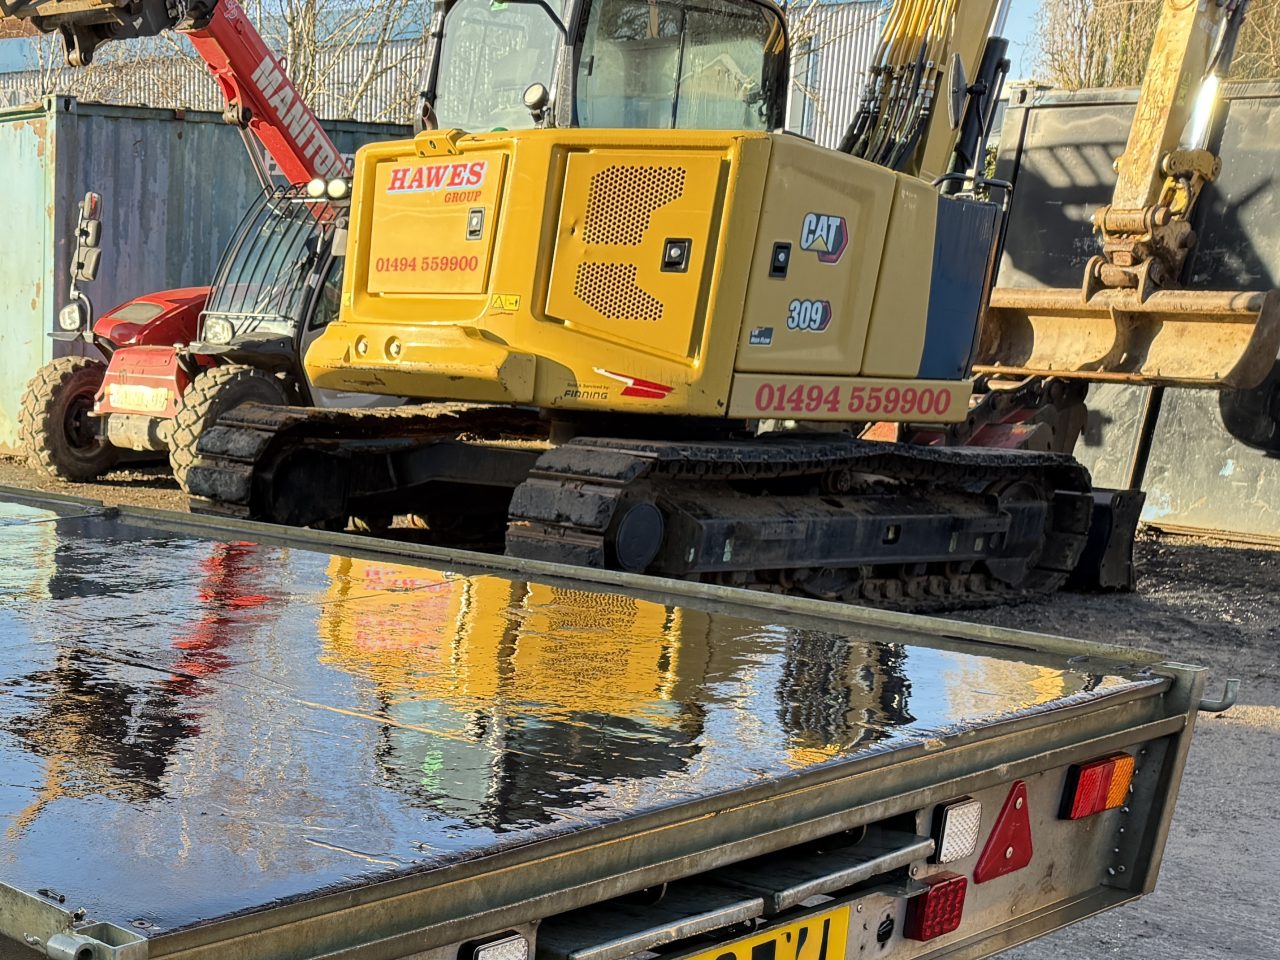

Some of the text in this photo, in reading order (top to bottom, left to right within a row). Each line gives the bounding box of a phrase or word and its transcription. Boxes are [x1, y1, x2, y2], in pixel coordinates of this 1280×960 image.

[387, 161, 485, 191] HAWES
[444, 191, 481, 203] GROUP
[801, 213, 840, 252] CAT
[376, 256, 478, 272] 01494 559900
[787, 300, 823, 329] 309
[564, 390, 608, 400] FINNING
[755, 383, 952, 415] 01494 559900
